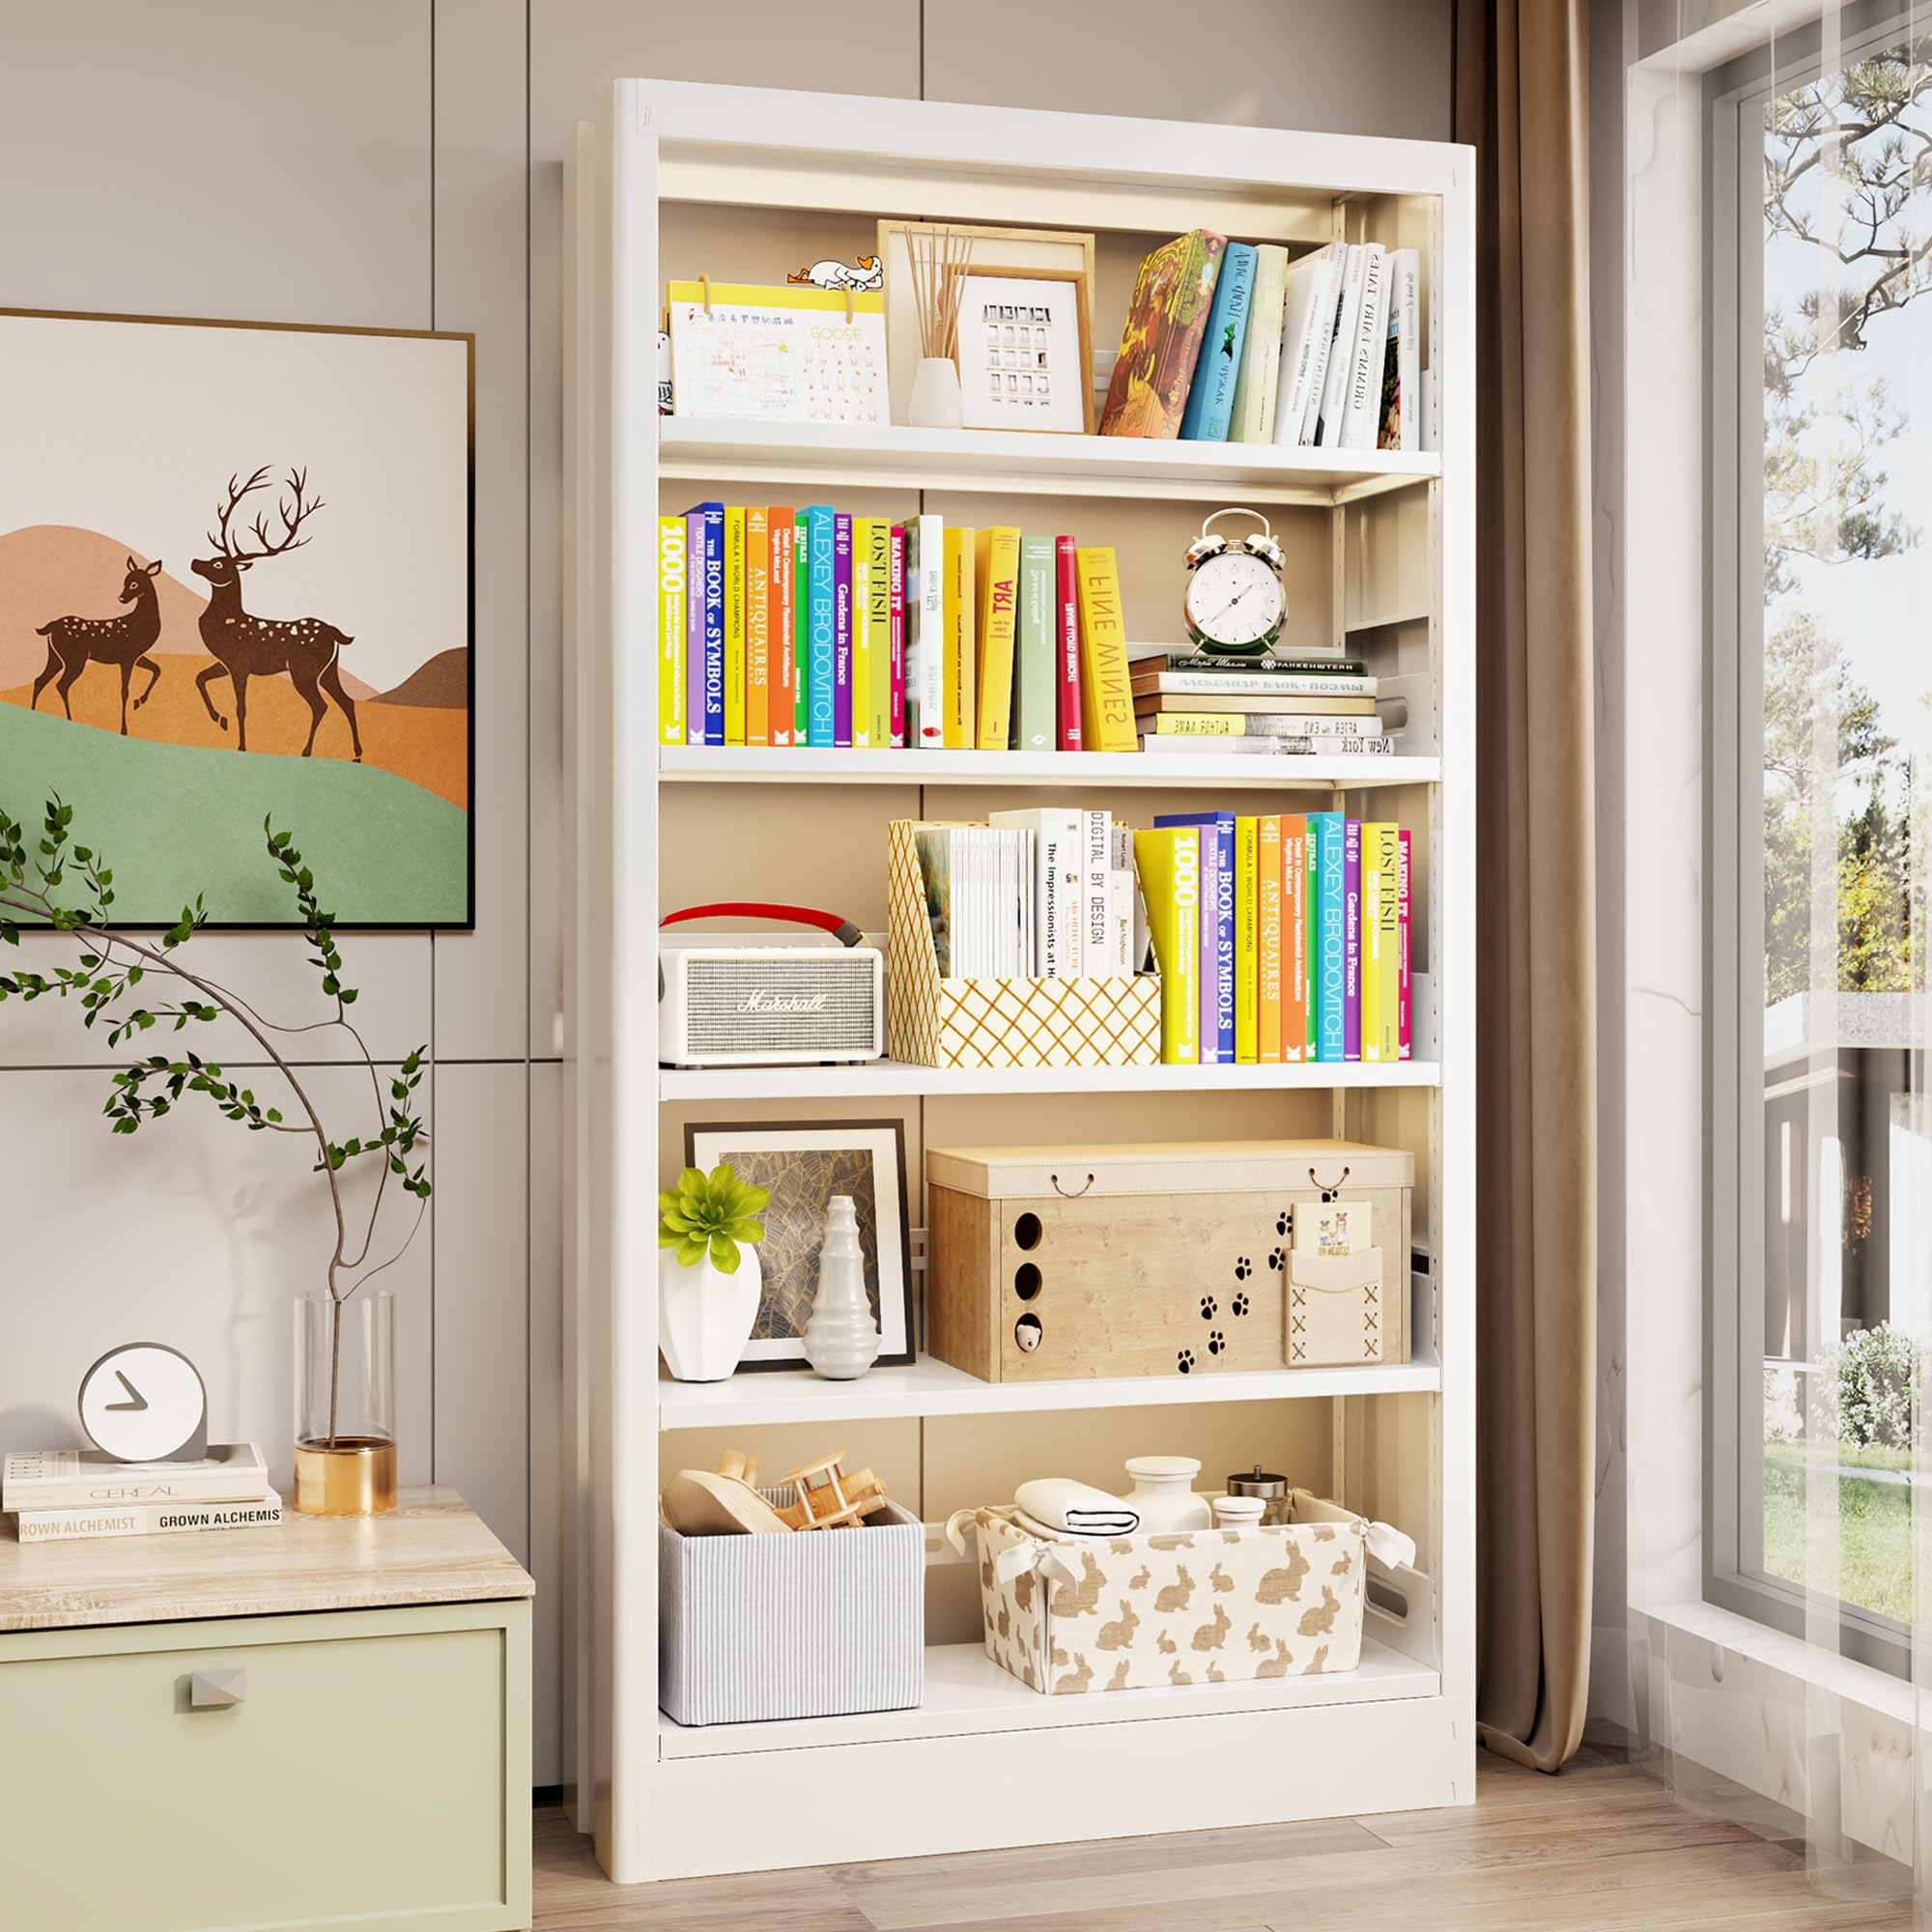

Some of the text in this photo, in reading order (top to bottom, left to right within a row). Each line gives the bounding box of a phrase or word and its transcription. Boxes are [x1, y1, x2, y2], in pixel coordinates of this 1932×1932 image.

[810, 326, 864, 341] GOOSE
[1215, 365, 1229, 405] ЧУЖАК
[662, 525, 684, 592] 1000
[707, 559, 721, 610] BOOK
[871, 525, 887, 623] LOST FISH
[892, 536, 901, 594] MAKING
[752, 567, 766, 685] ANTIQUAIRES
[813, 511, 832, 731] ALEXEY BRODOVITCH
[892, 596, 901, 611] IT
[838, 583, 848, 685] Gardens in France
[707, 627, 721, 714] SYMBOLS
[1310, 682, 1364, 692] ПОЭМЫ
[1047, 842, 1057, 863] The
[1092, 811, 1104, 945] DIGITAL BY DESIGN
[1175, 837, 1197, 906] 1000
[1380, 830, 1395, 931] LOST FISH
[1399, 840, 1408, 898] MAKING
[1046, 867, 1057, 949] Impressionists
[1219, 871, 1233, 923] BOOK
[1399, 900, 1408, 917] IT
[1047, 952, 1055, 964] at
[1264, 879, 1279, 1001] ANTIQUAIRES
[1323, 818, 1343, 1047] ALEXEY BRODOVITCH
[1347, 893, 1358, 997] Gardens in France
[737, 989, 828, 1011] Marshall
[1219, 941, 1233, 1030] SYMBOLS
[90, 1486, 179, 1499] CEREAL
[159, 1509, 282, 1528] GROWN ALCHEMIS
[64, 1517, 135, 1533] ALCHEMIST
